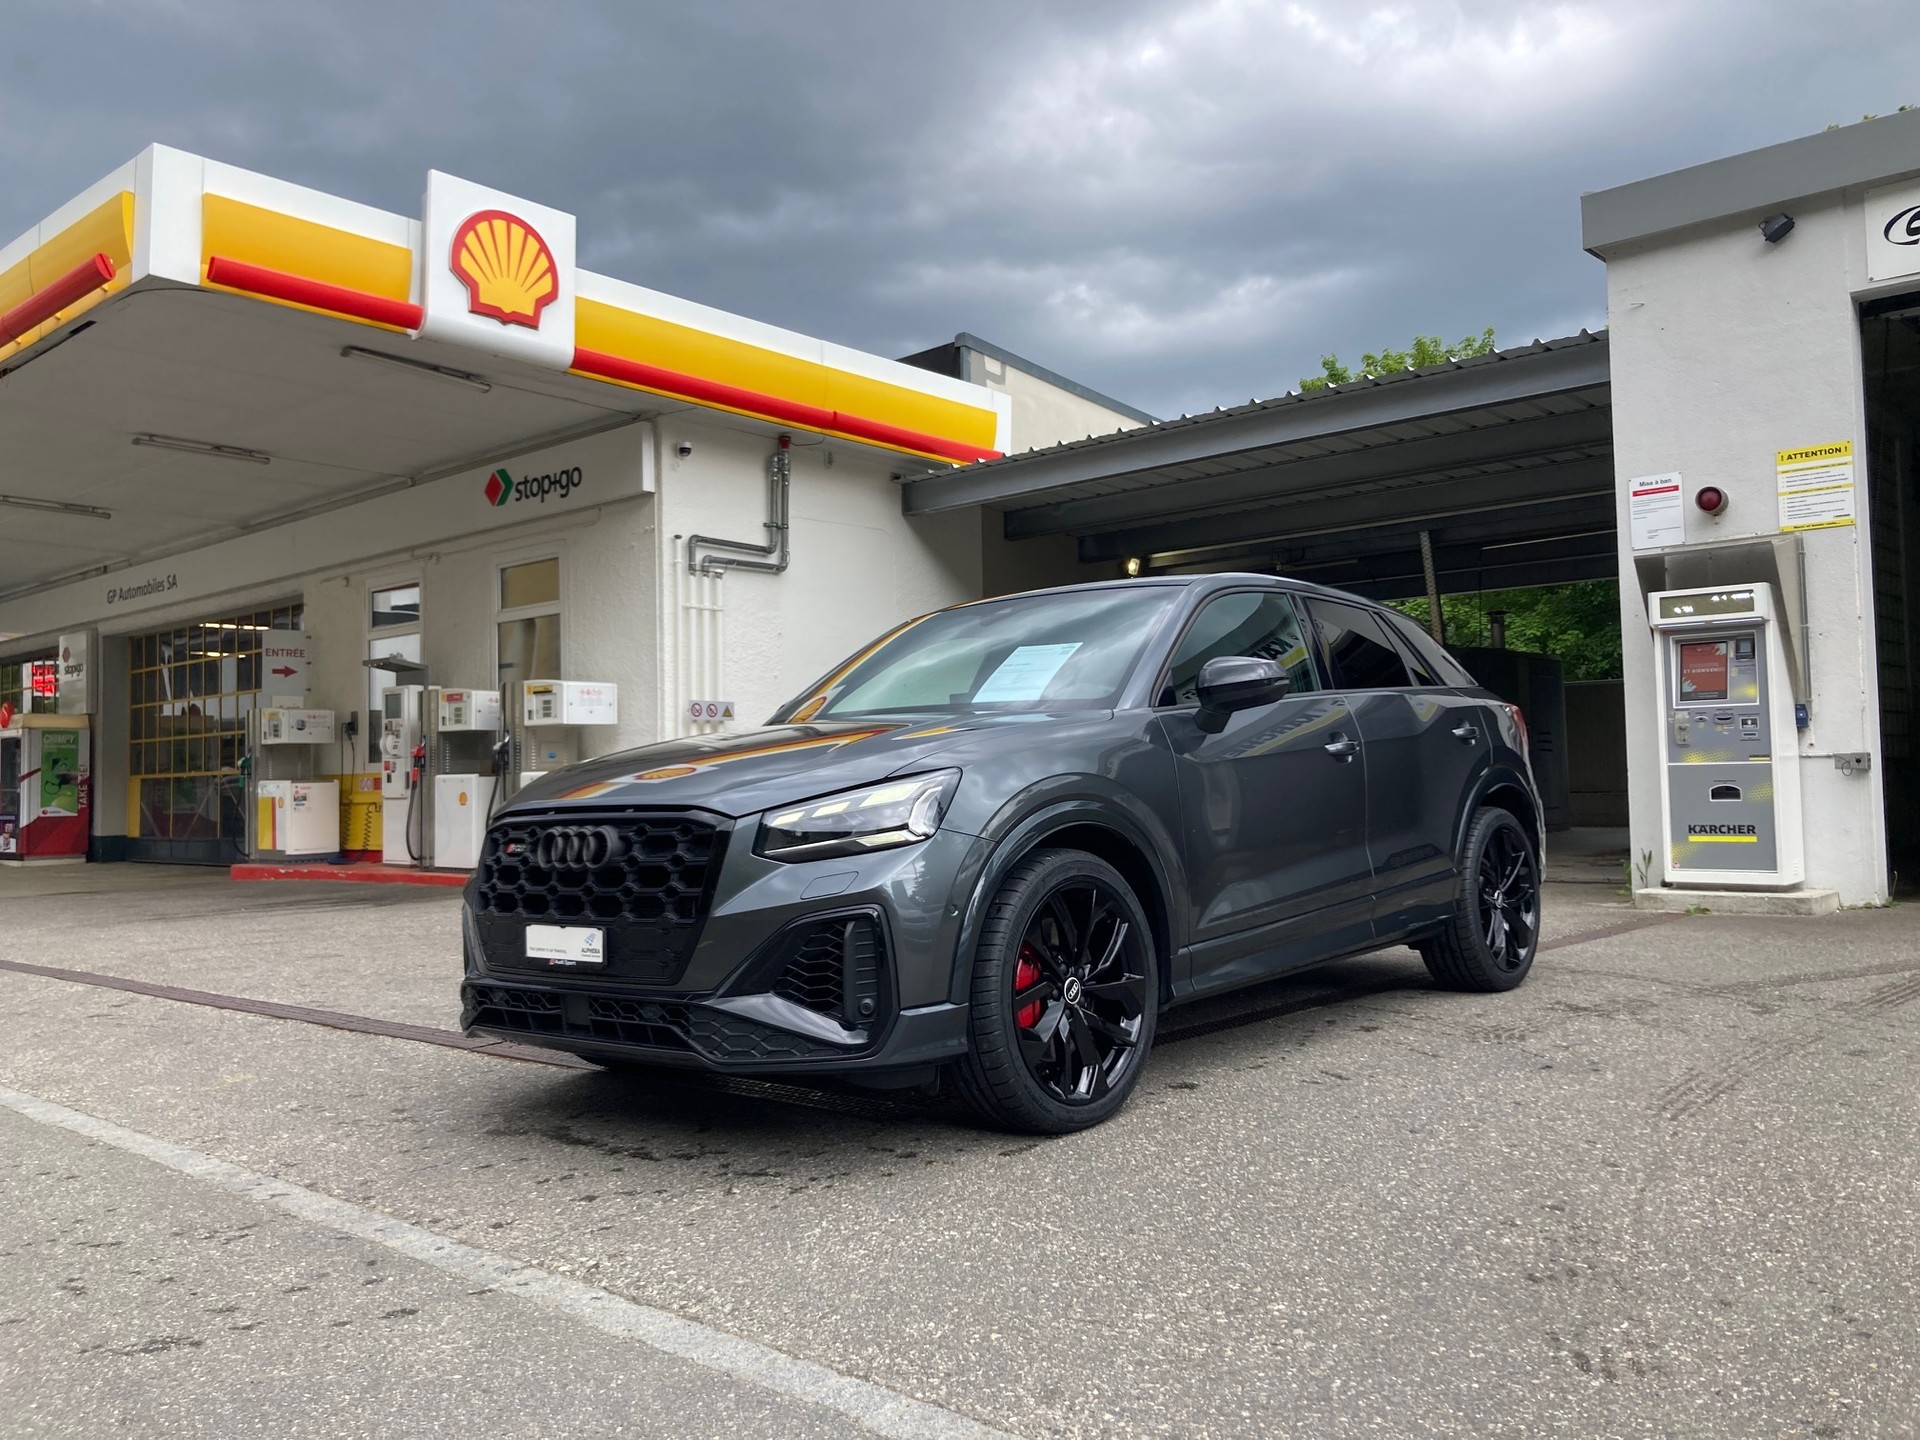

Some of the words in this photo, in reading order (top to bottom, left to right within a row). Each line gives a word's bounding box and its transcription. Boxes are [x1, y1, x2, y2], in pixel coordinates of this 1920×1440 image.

[1786, 447, 1842, 461] ATTENTION
[514, 466, 582, 503] stop+go
[107, 589, 117, 604] GP
[118, 577, 165, 601] Automobiles
[167, 573, 178, 590] SA
[265, 648, 306, 658] ENTRÉE
[43, 733, 76, 745] CHIMPY
[78, 784, 88, 810] TAKE
[1688, 823, 1757, 835] KÄRCHER
